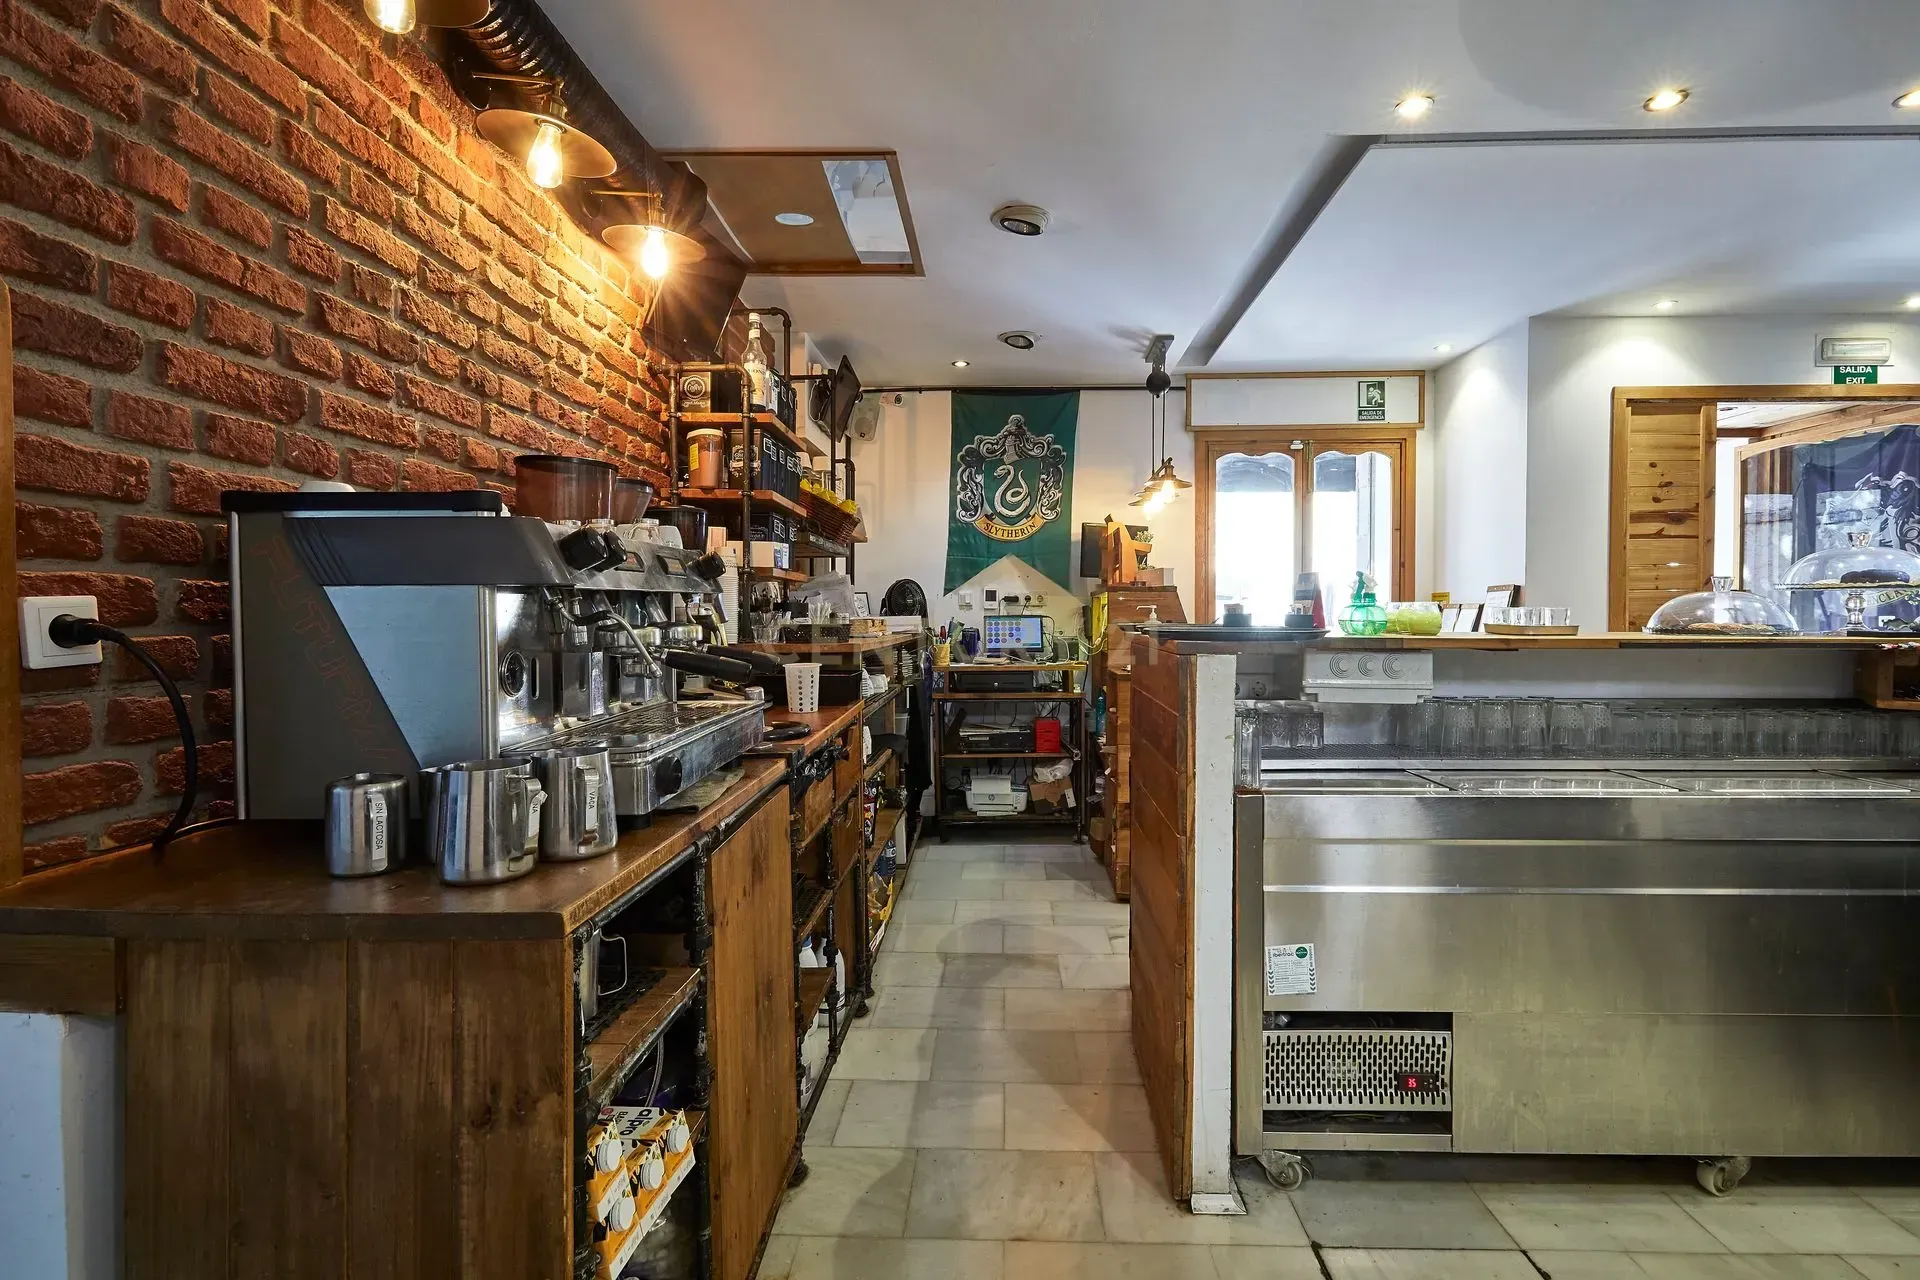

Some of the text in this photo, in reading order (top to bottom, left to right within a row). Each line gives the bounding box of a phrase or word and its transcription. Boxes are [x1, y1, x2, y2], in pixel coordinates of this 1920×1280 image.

[984, 522, 1036, 538] SLYTHERIN
[588, 790, 597, 810] VACA
[375, 802, 384, 851] SIN LACTOSA
[619, 1108, 653, 1136] alpro
